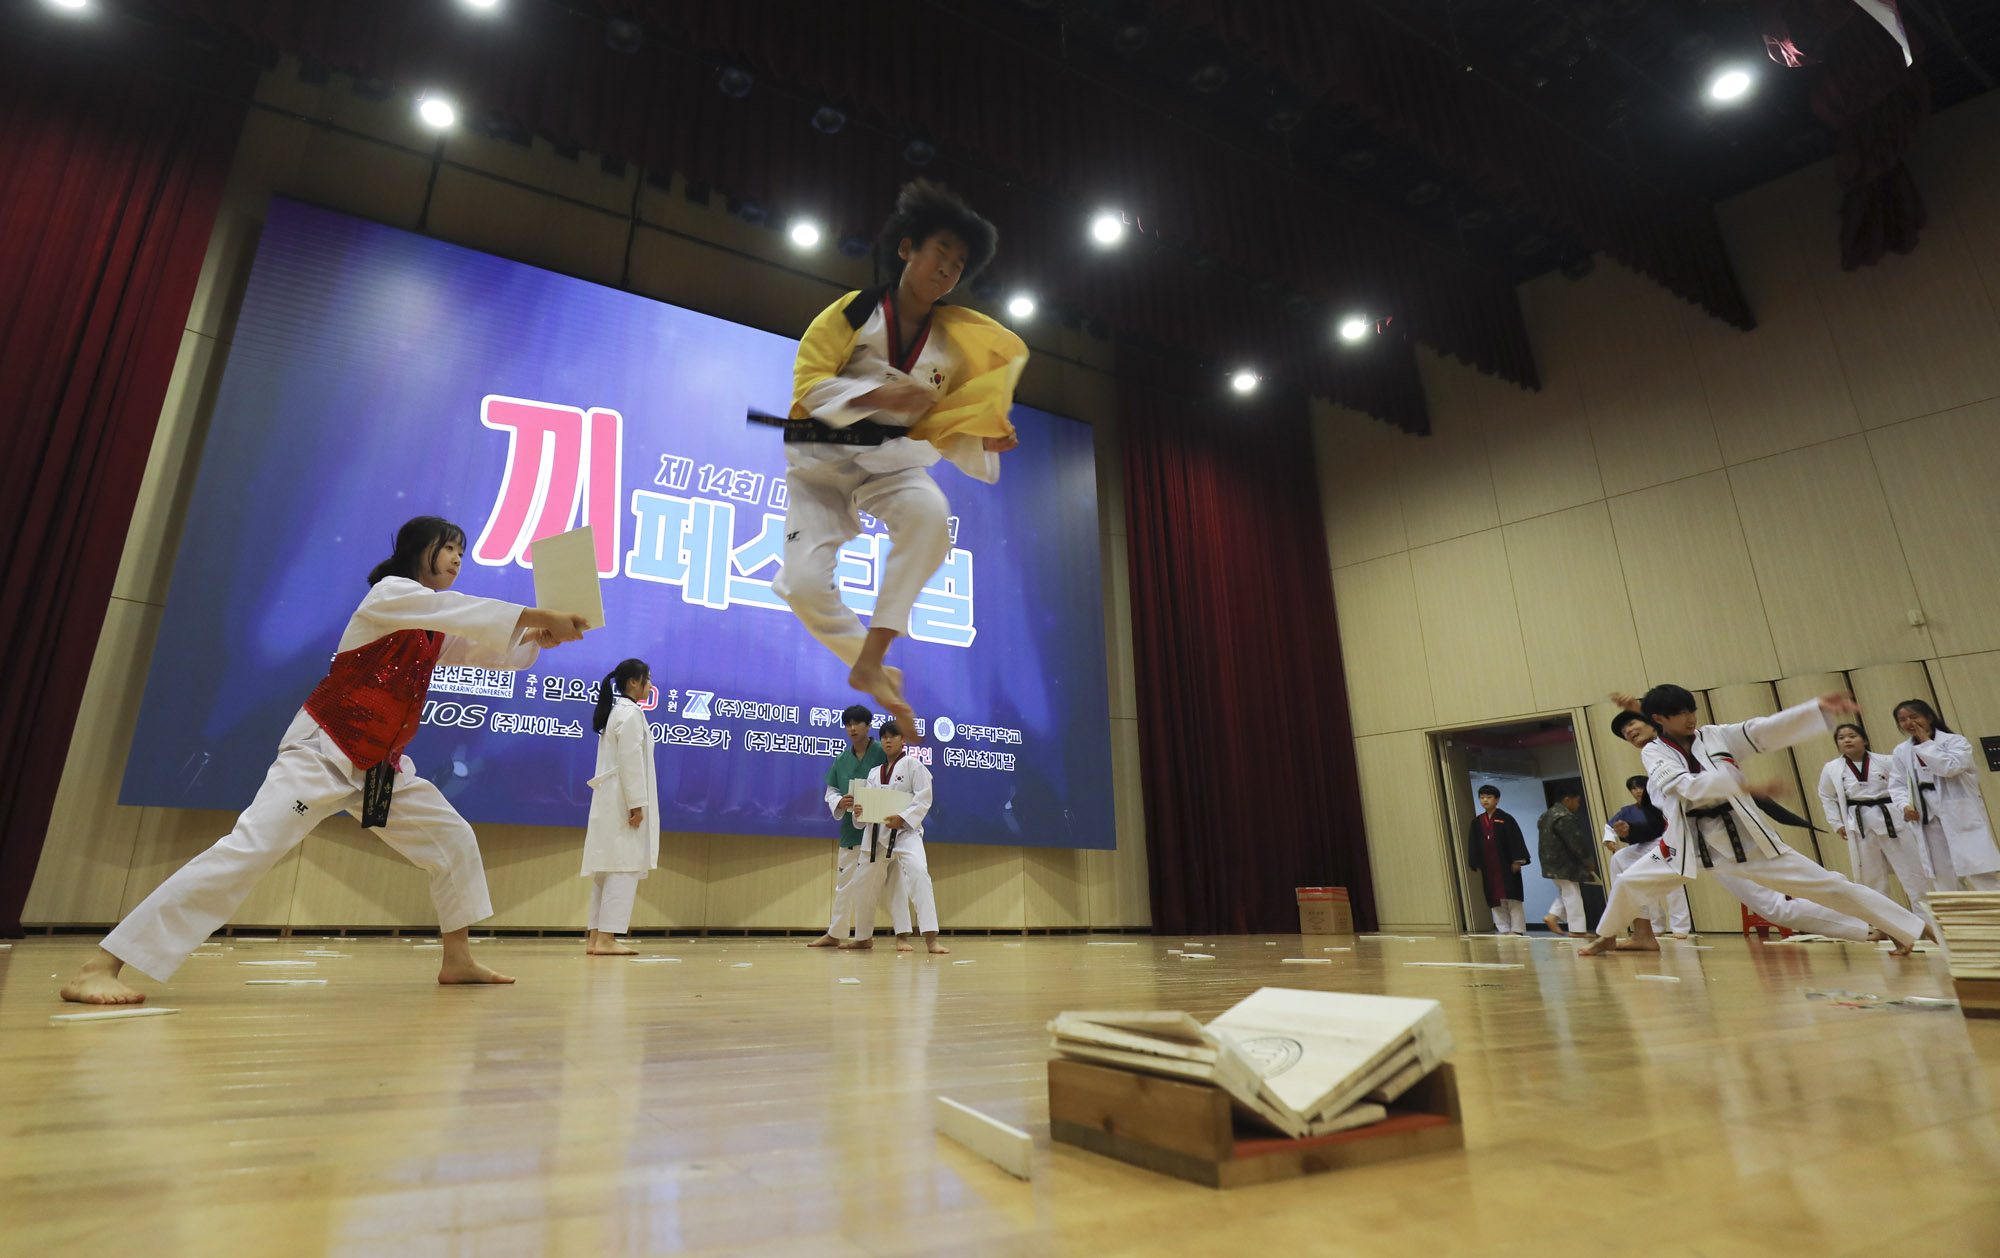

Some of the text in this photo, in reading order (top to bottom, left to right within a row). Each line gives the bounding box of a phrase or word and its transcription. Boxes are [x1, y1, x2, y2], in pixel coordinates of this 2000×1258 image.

[472, 394, 623, 579] 끼
[654, 453, 694, 490] 제
[698, 464, 765, 504] 14회
[449, 684, 474, 694] REARING
[475, 686, 512, 698] CONFERENCE
[715, 698, 799, 723] (주)엘에이티
[491, 712, 584, 738] (주)싸이노스
[956, 723, 1022, 744] 아주대학교
[943, 747, 1016, 771] (주)삼천개발
